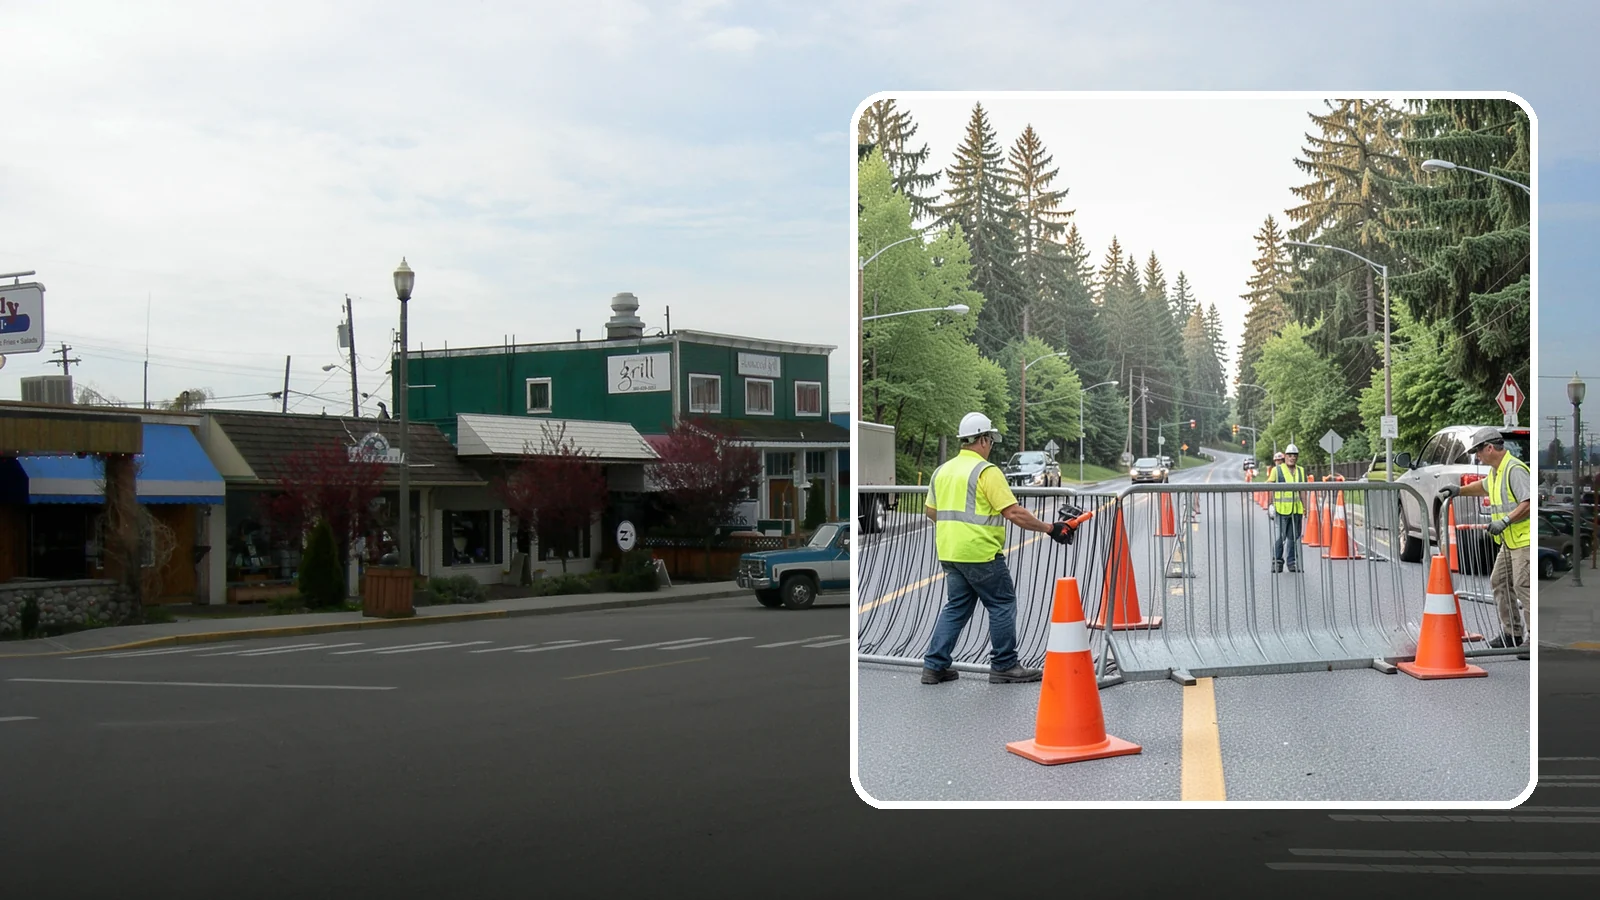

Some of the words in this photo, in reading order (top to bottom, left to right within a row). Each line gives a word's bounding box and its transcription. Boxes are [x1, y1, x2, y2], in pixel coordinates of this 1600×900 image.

[3, 338, 16, 346] Fries
[20, 337, 38, 345] Salads
[618, 356, 655, 391] grill
